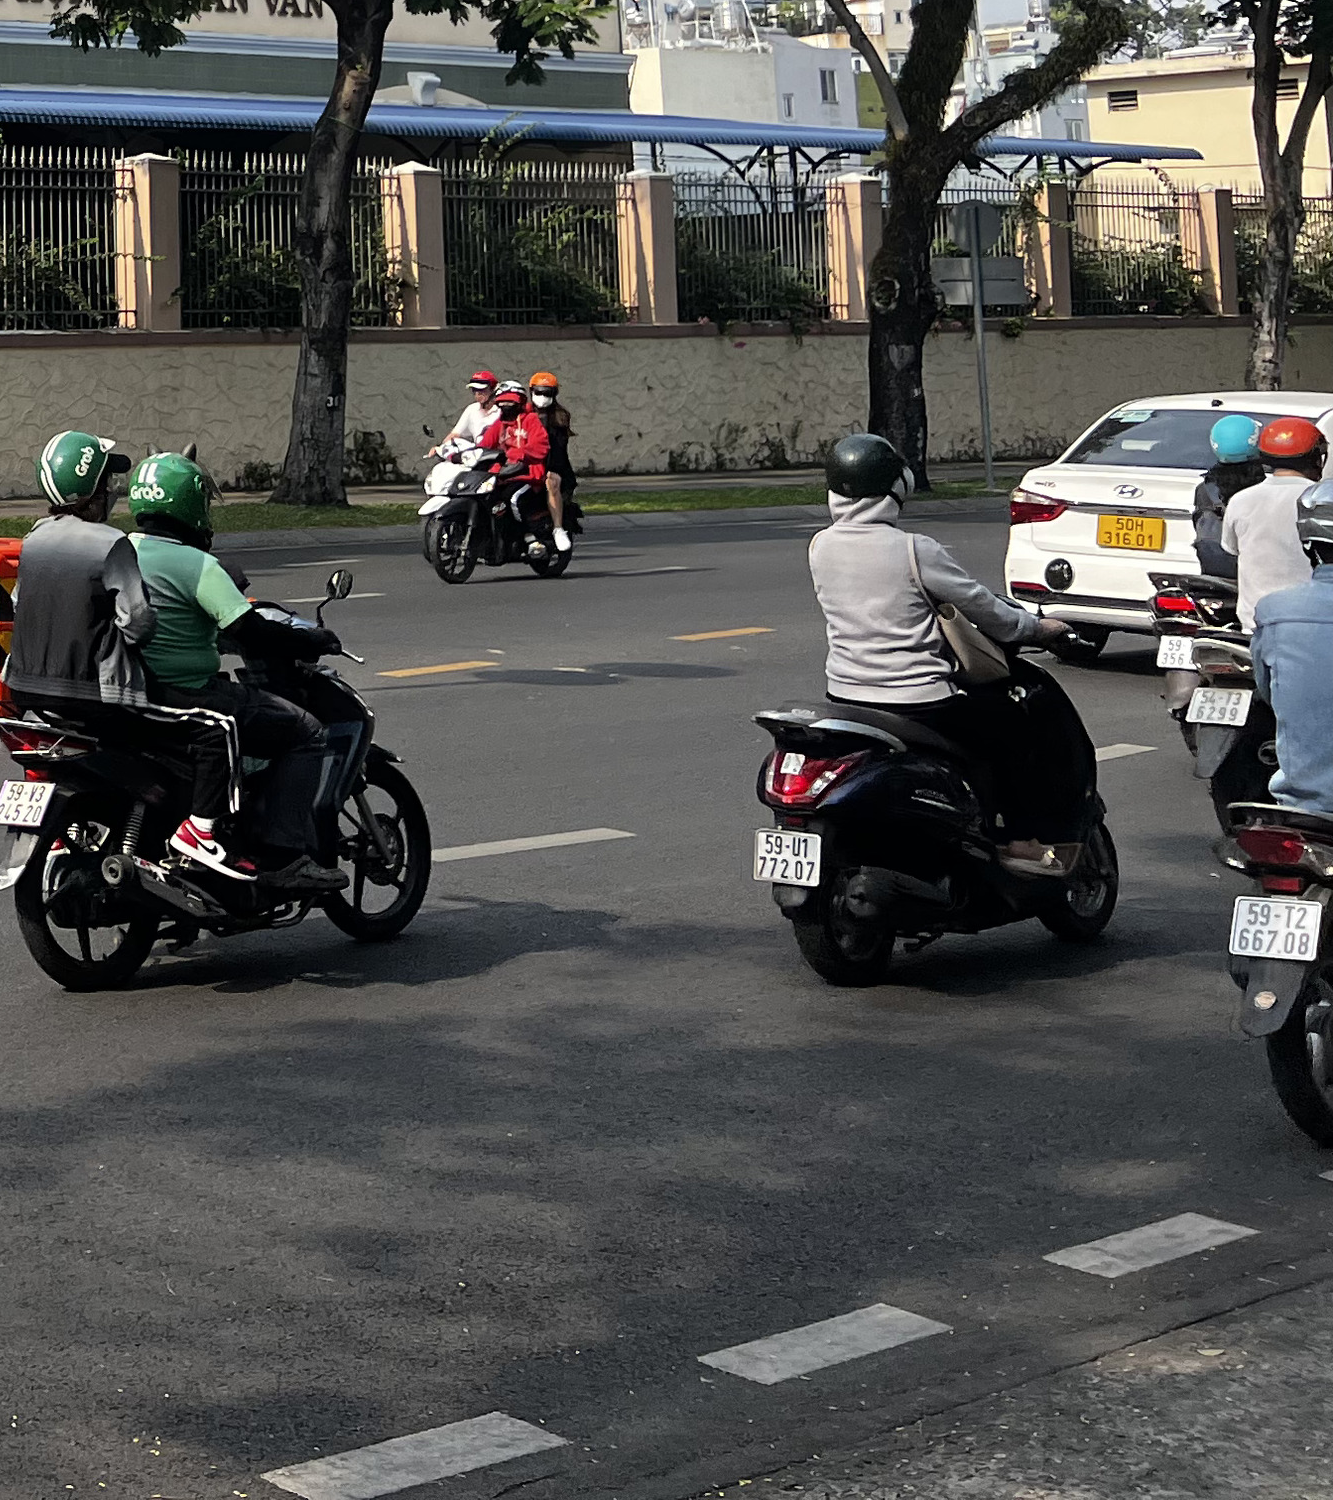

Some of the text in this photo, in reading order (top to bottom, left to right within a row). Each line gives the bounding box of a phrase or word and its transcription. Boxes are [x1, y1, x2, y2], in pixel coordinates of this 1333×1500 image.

[74, 446, 95, 477] Grab
[130, 483, 165, 502] Grab
[1115, 517, 1144, 532] 50H
[1196, 706, 1238, 721] 6299
[7, 784, 46, 802] 59-V3
[765, 834, 808, 858] 59-U1
[1247, 903, 1308, 929] 59-T2
[1238, 928, 1310, 956] 667.08
